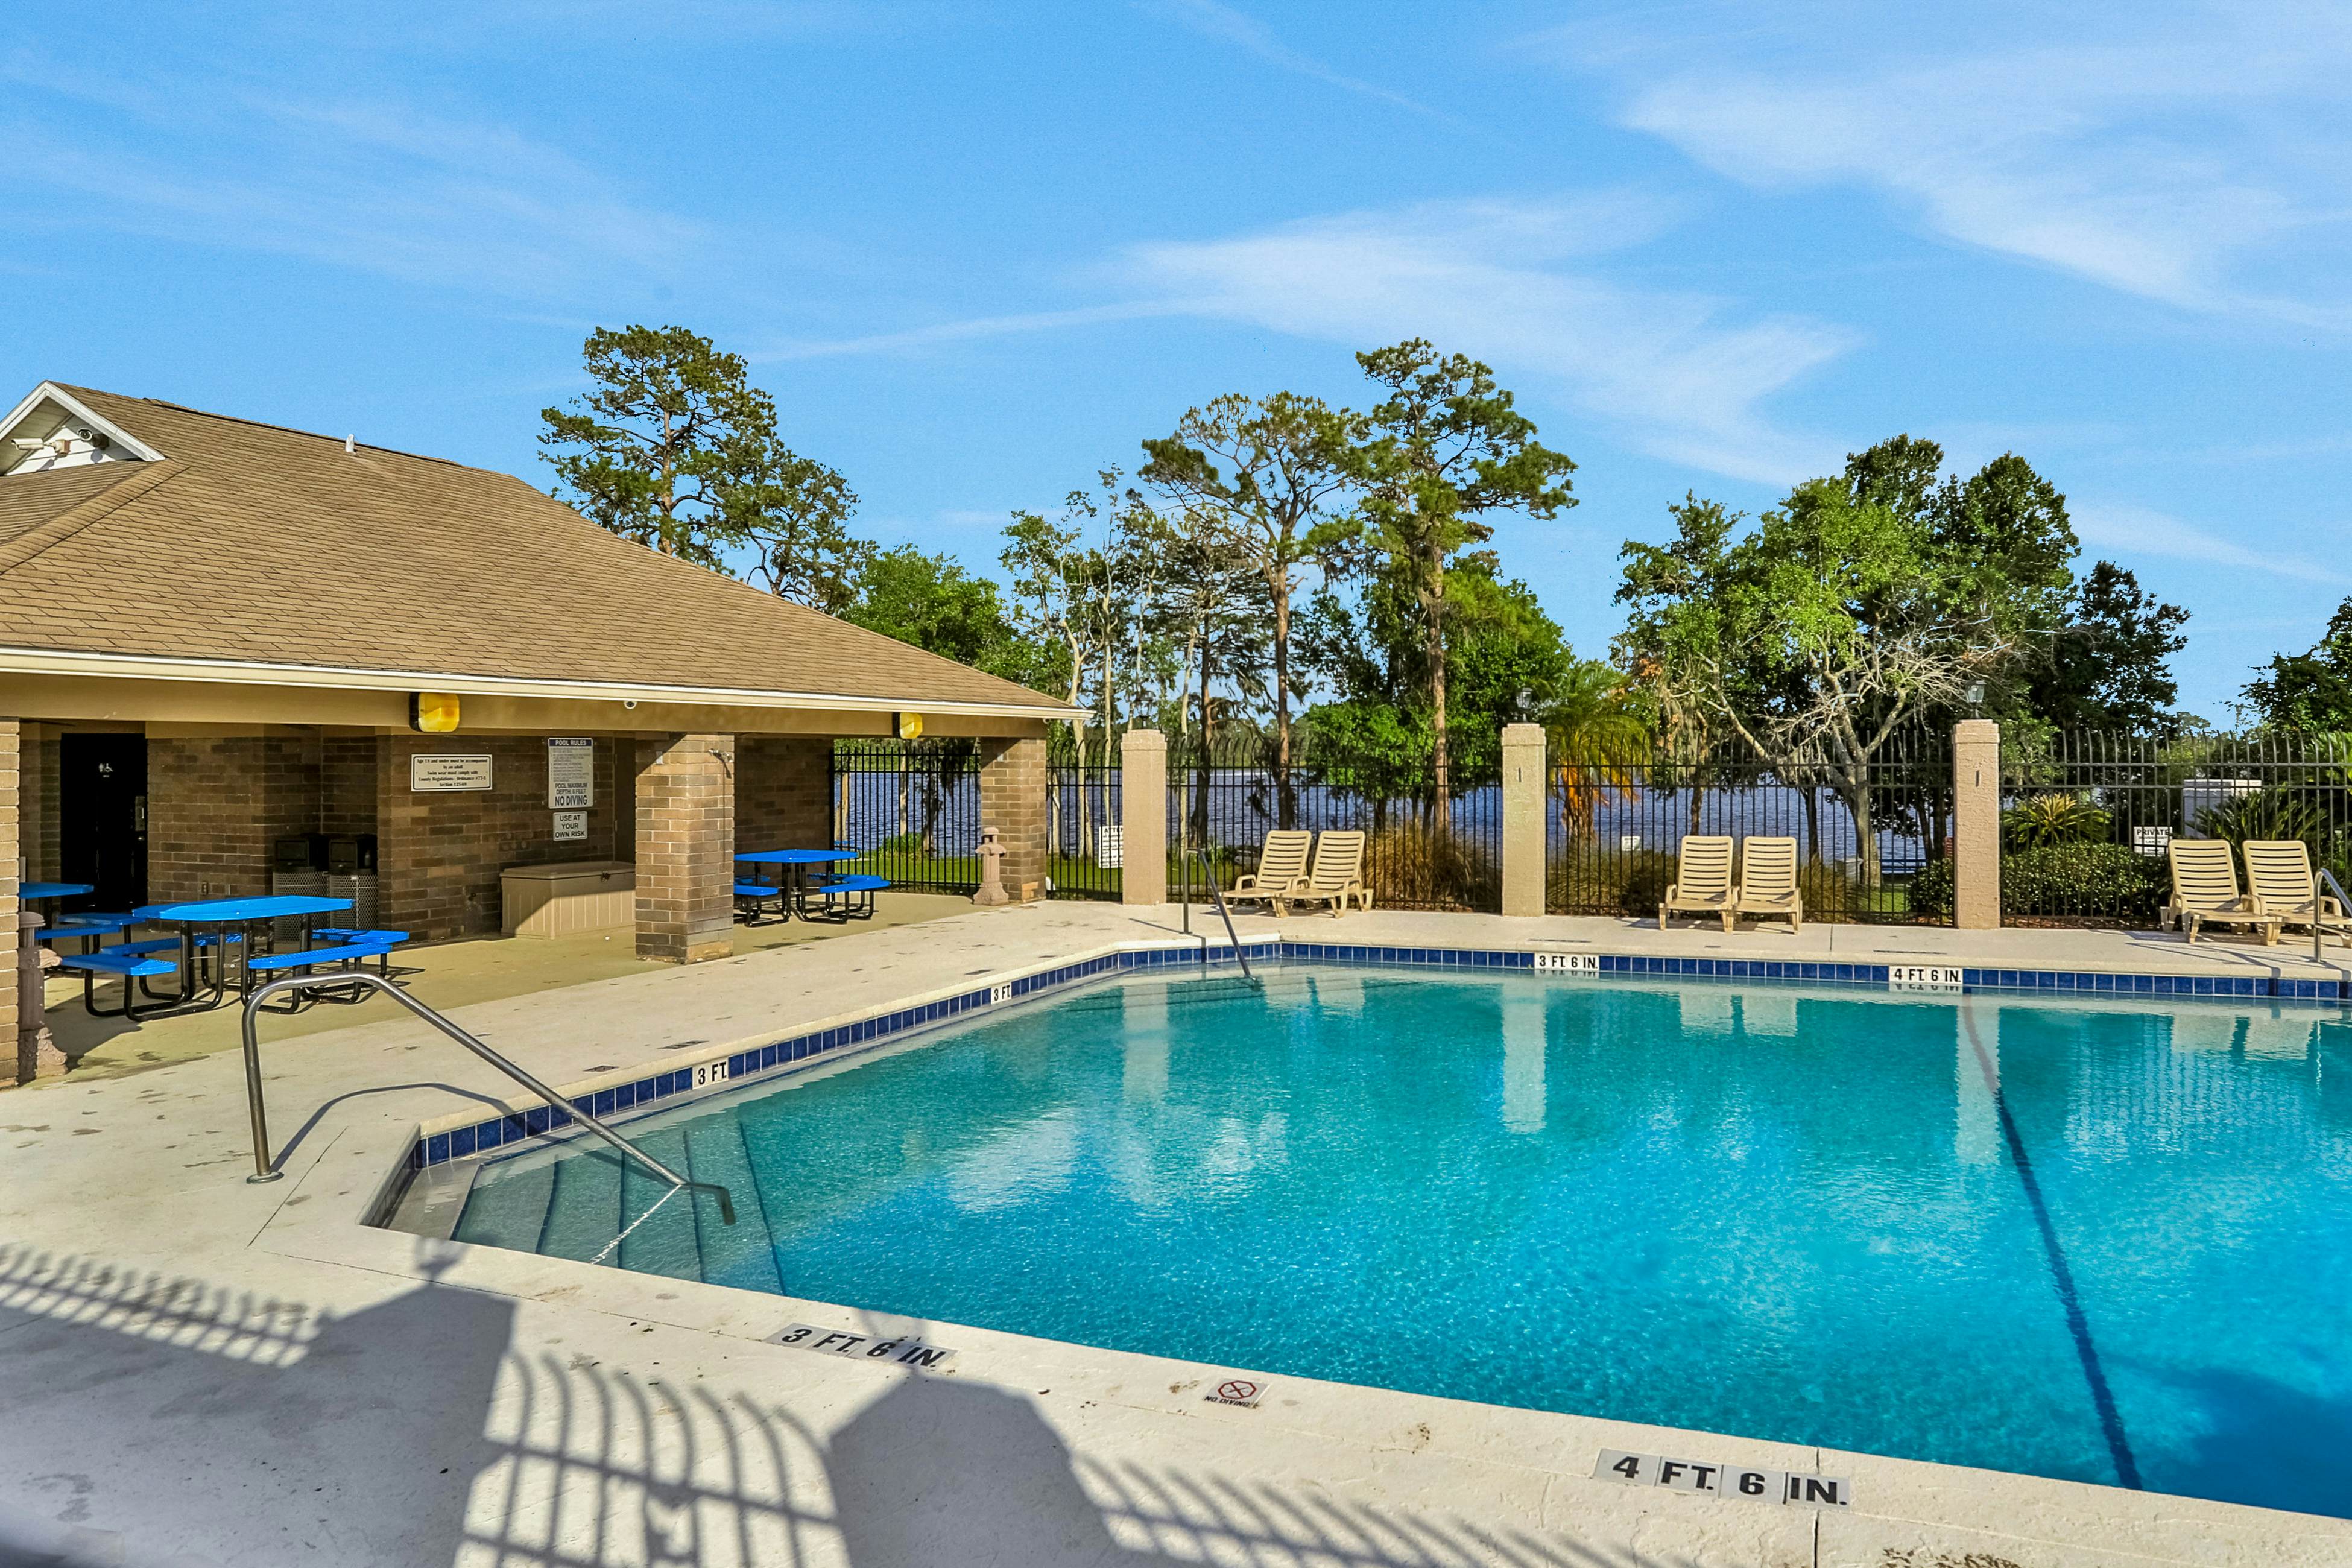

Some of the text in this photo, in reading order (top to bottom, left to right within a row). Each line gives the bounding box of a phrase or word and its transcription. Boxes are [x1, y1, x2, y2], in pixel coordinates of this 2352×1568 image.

[555, 795, 587, 806] NO DIVING
[1539, 955, 1598, 969] 3 FT. 6 IN.
[1894, 968, 1961, 982] 4 FT. 6 IN.
[994, 988, 999, 1001] 3
[698, 1061, 727, 1085] 3 FT.
[781, 1328, 947, 1368] 3 FT. 6 IN.
[1219, 1399, 1250, 1408] DIVING
[1612, 1456, 1848, 1506] 4 FT. 6 IN.
